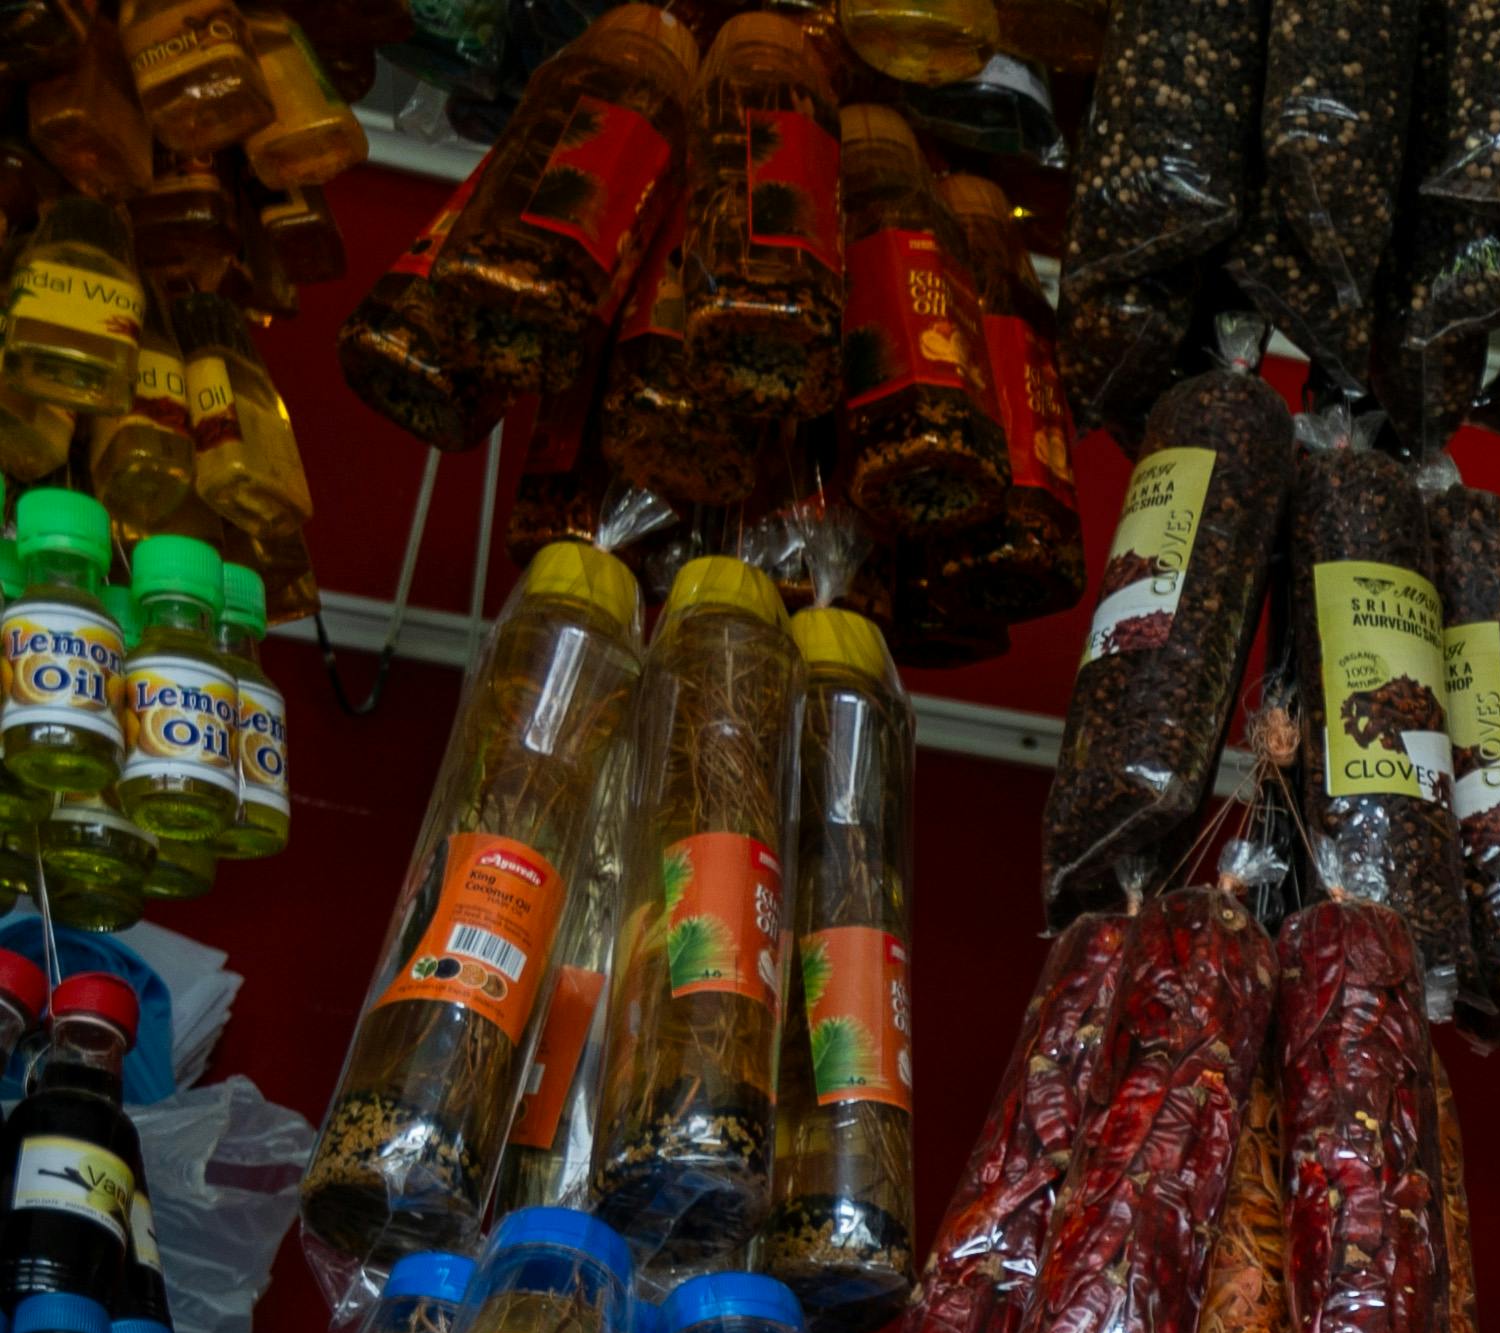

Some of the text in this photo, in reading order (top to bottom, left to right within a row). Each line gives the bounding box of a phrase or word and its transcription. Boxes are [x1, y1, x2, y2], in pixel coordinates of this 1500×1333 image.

[1151, 509, 1195, 597] CLOVES
[1351, 598, 1387, 615] SRI
[1352, 614, 1423, 643] AYURVEDIC
[33, 666, 107, 705] Oil
[163, 720, 230, 758] Oil
[1345, 758, 1436, 789] CLOVES
